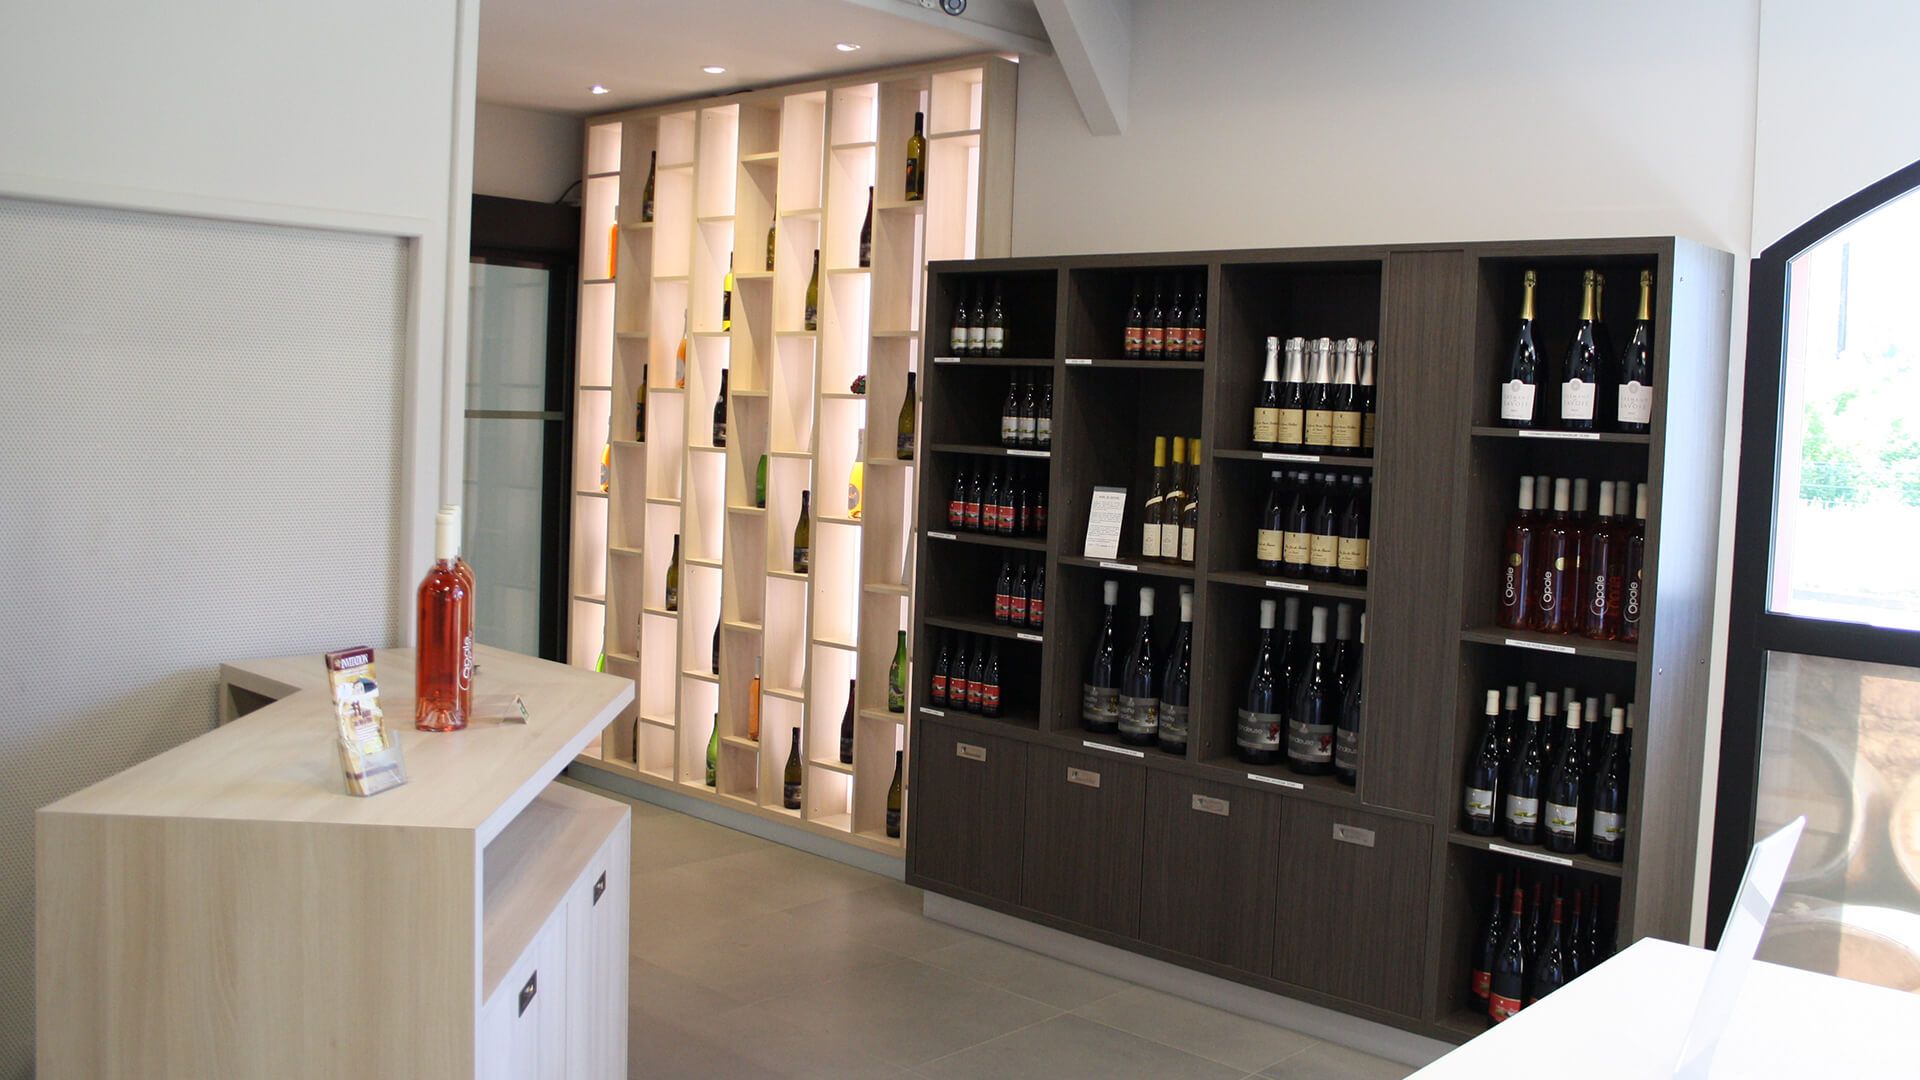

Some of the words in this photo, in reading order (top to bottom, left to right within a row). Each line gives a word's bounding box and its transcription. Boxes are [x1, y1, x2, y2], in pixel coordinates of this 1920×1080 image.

[1505, 567, 1515, 598] Opale
[1542, 571, 1553, 602] Opale
[1594, 575, 1606, 607] Opale
[1626, 582, 1638, 614] Opale
